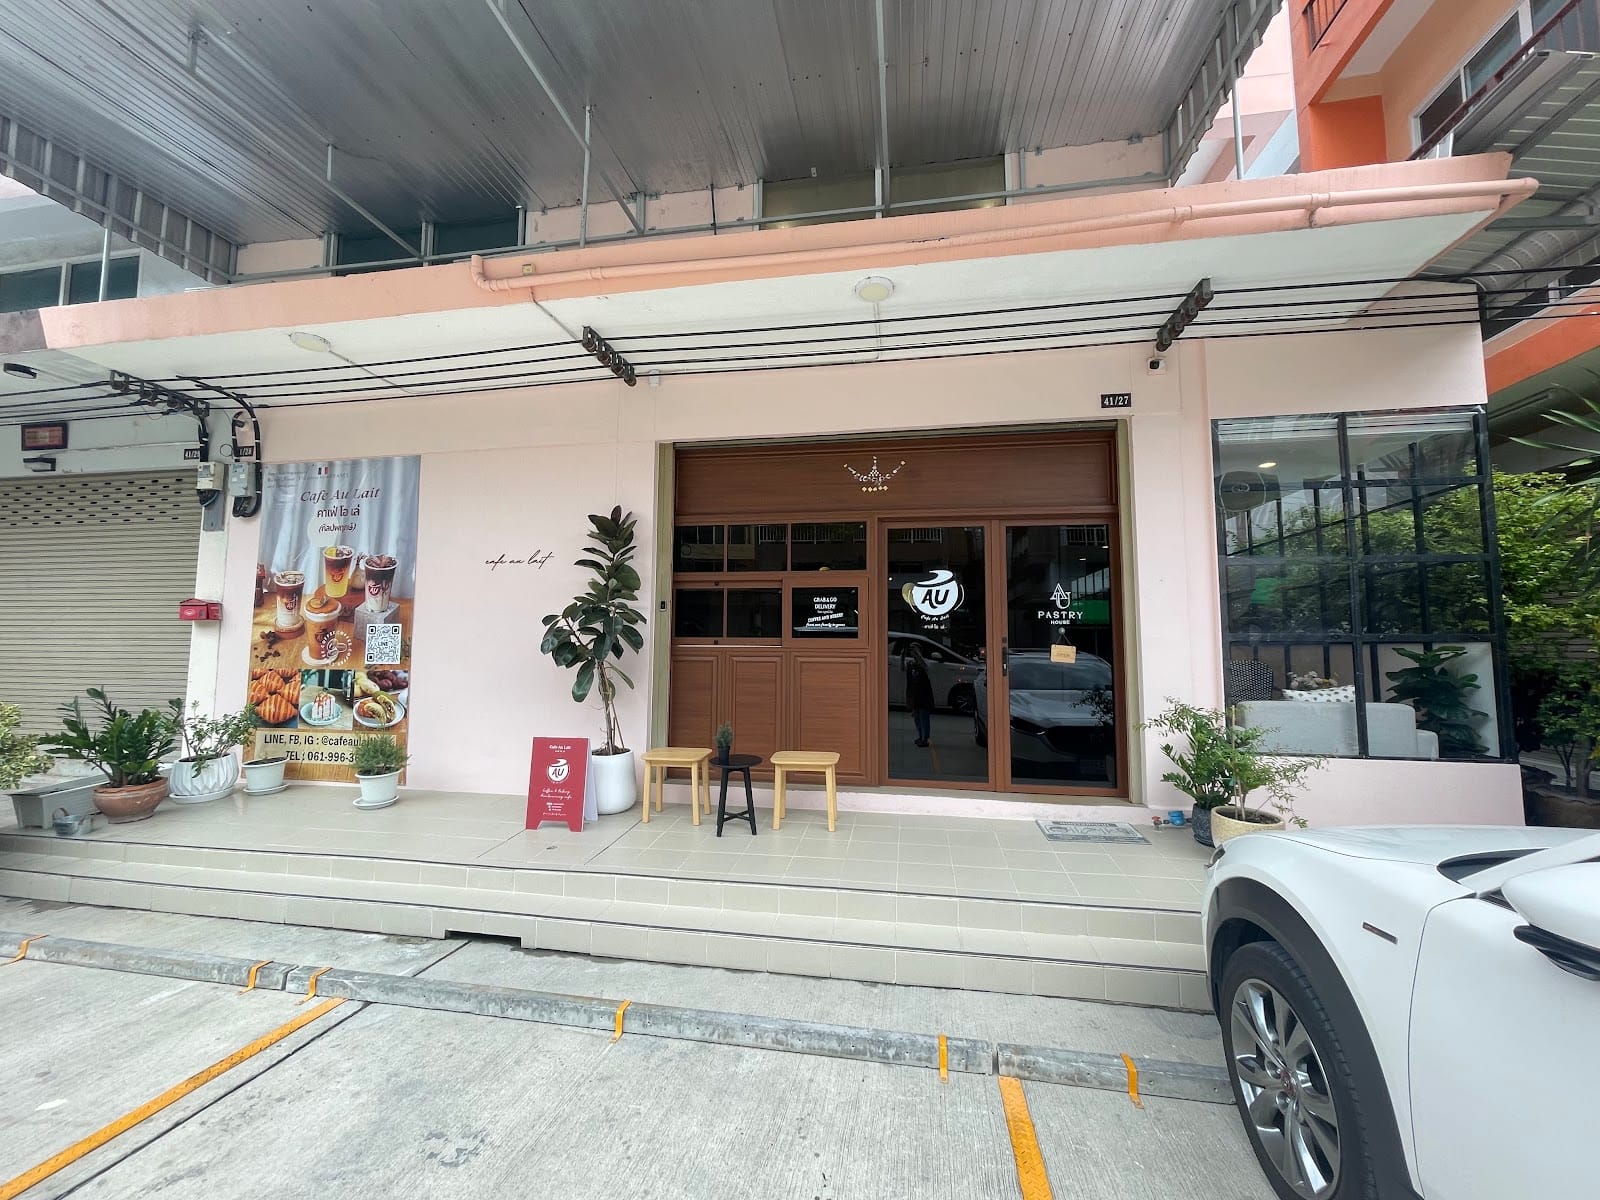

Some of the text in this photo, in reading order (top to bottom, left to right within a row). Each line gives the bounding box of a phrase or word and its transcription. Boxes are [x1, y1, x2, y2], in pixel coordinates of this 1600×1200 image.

[1104, 395, 1129, 406] 41/27
[300, 487, 381, 503] Cafe Au Lait
[921, 589, 950, 609] AU
[1037, 611, 1084, 619] PASTRY
[264, 734, 287, 745] LINE,
[304, 735, 315, 746] IG
